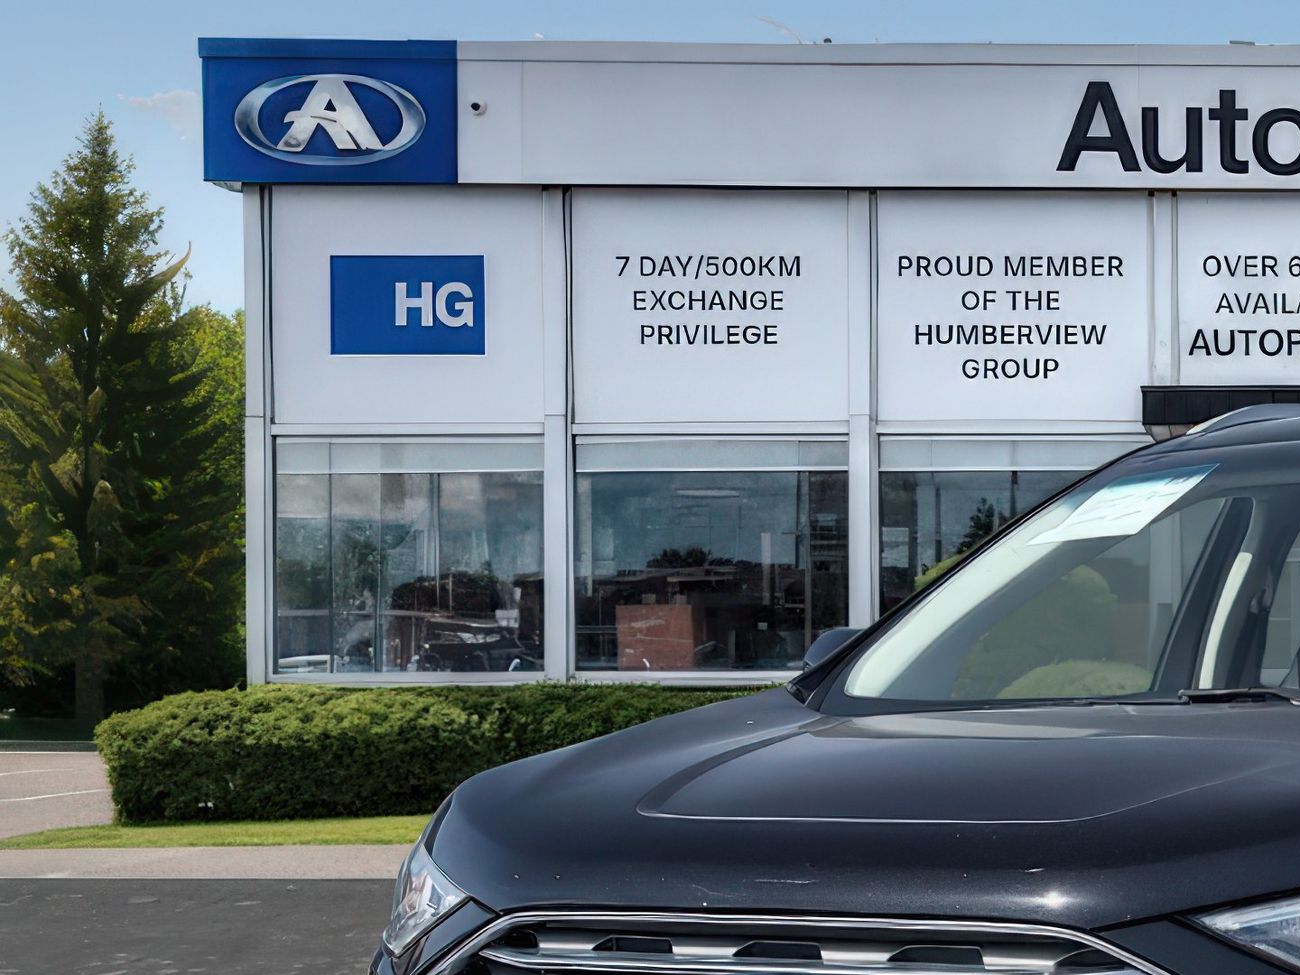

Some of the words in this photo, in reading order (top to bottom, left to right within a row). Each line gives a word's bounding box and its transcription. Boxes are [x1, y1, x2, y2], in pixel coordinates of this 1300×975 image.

[615, 255, 631, 277] 7
[639, 254, 801, 280] DAY/500KM
[898, 255, 994, 277] PROUD
[1004, 255, 1124, 277] MEMBER
[1202, 254, 1279, 278] OVER
[395, 281, 474, 327] HG
[633, 289, 784, 311] EXCHANGE
[961, 290, 997, 311] OF
[1005, 290, 1060, 311] THE
[640, 324, 778, 345] PRIVILEGE
[914, 324, 1107, 346] HUMBERVIEW
[961, 357, 1060, 380] GROUP
